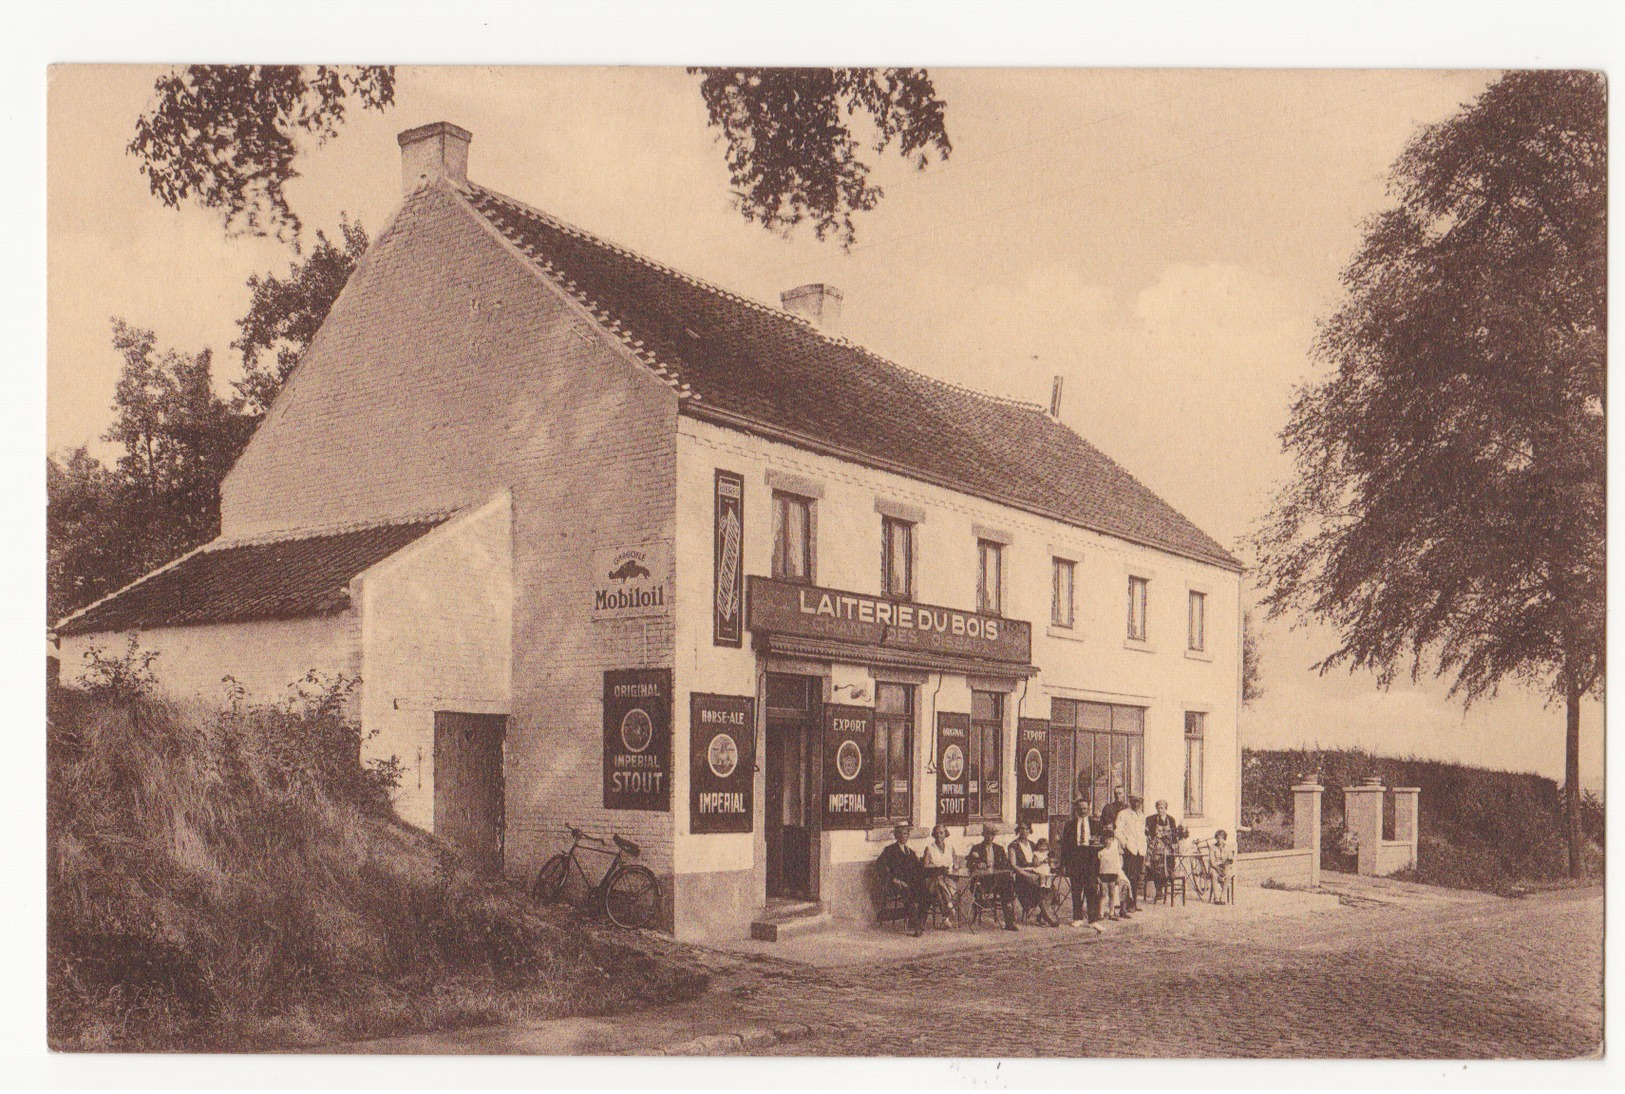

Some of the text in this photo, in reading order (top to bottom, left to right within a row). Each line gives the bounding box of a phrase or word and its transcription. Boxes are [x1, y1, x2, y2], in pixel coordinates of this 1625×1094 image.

[614, 550, 646, 565] GARGOYLE
[595, 585, 664, 610] Mobiloil
[800, 589, 998, 641] LAITERIE DU BOIS
[614, 684, 660, 697] ORIGINAL
[701, 709, 744, 725] HORSE-ALE
[833, 718, 867, 732] EXPORT
[1023, 730, 1047, 741] EXPORT
[614, 754, 660, 769] IMPERIAL
[612, 771, 663, 793] STOUT
[700, 792, 746, 813] IMPERIAL
[829, 794, 867, 812] IMPERIAL
[940, 798, 965, 814] STOUT
